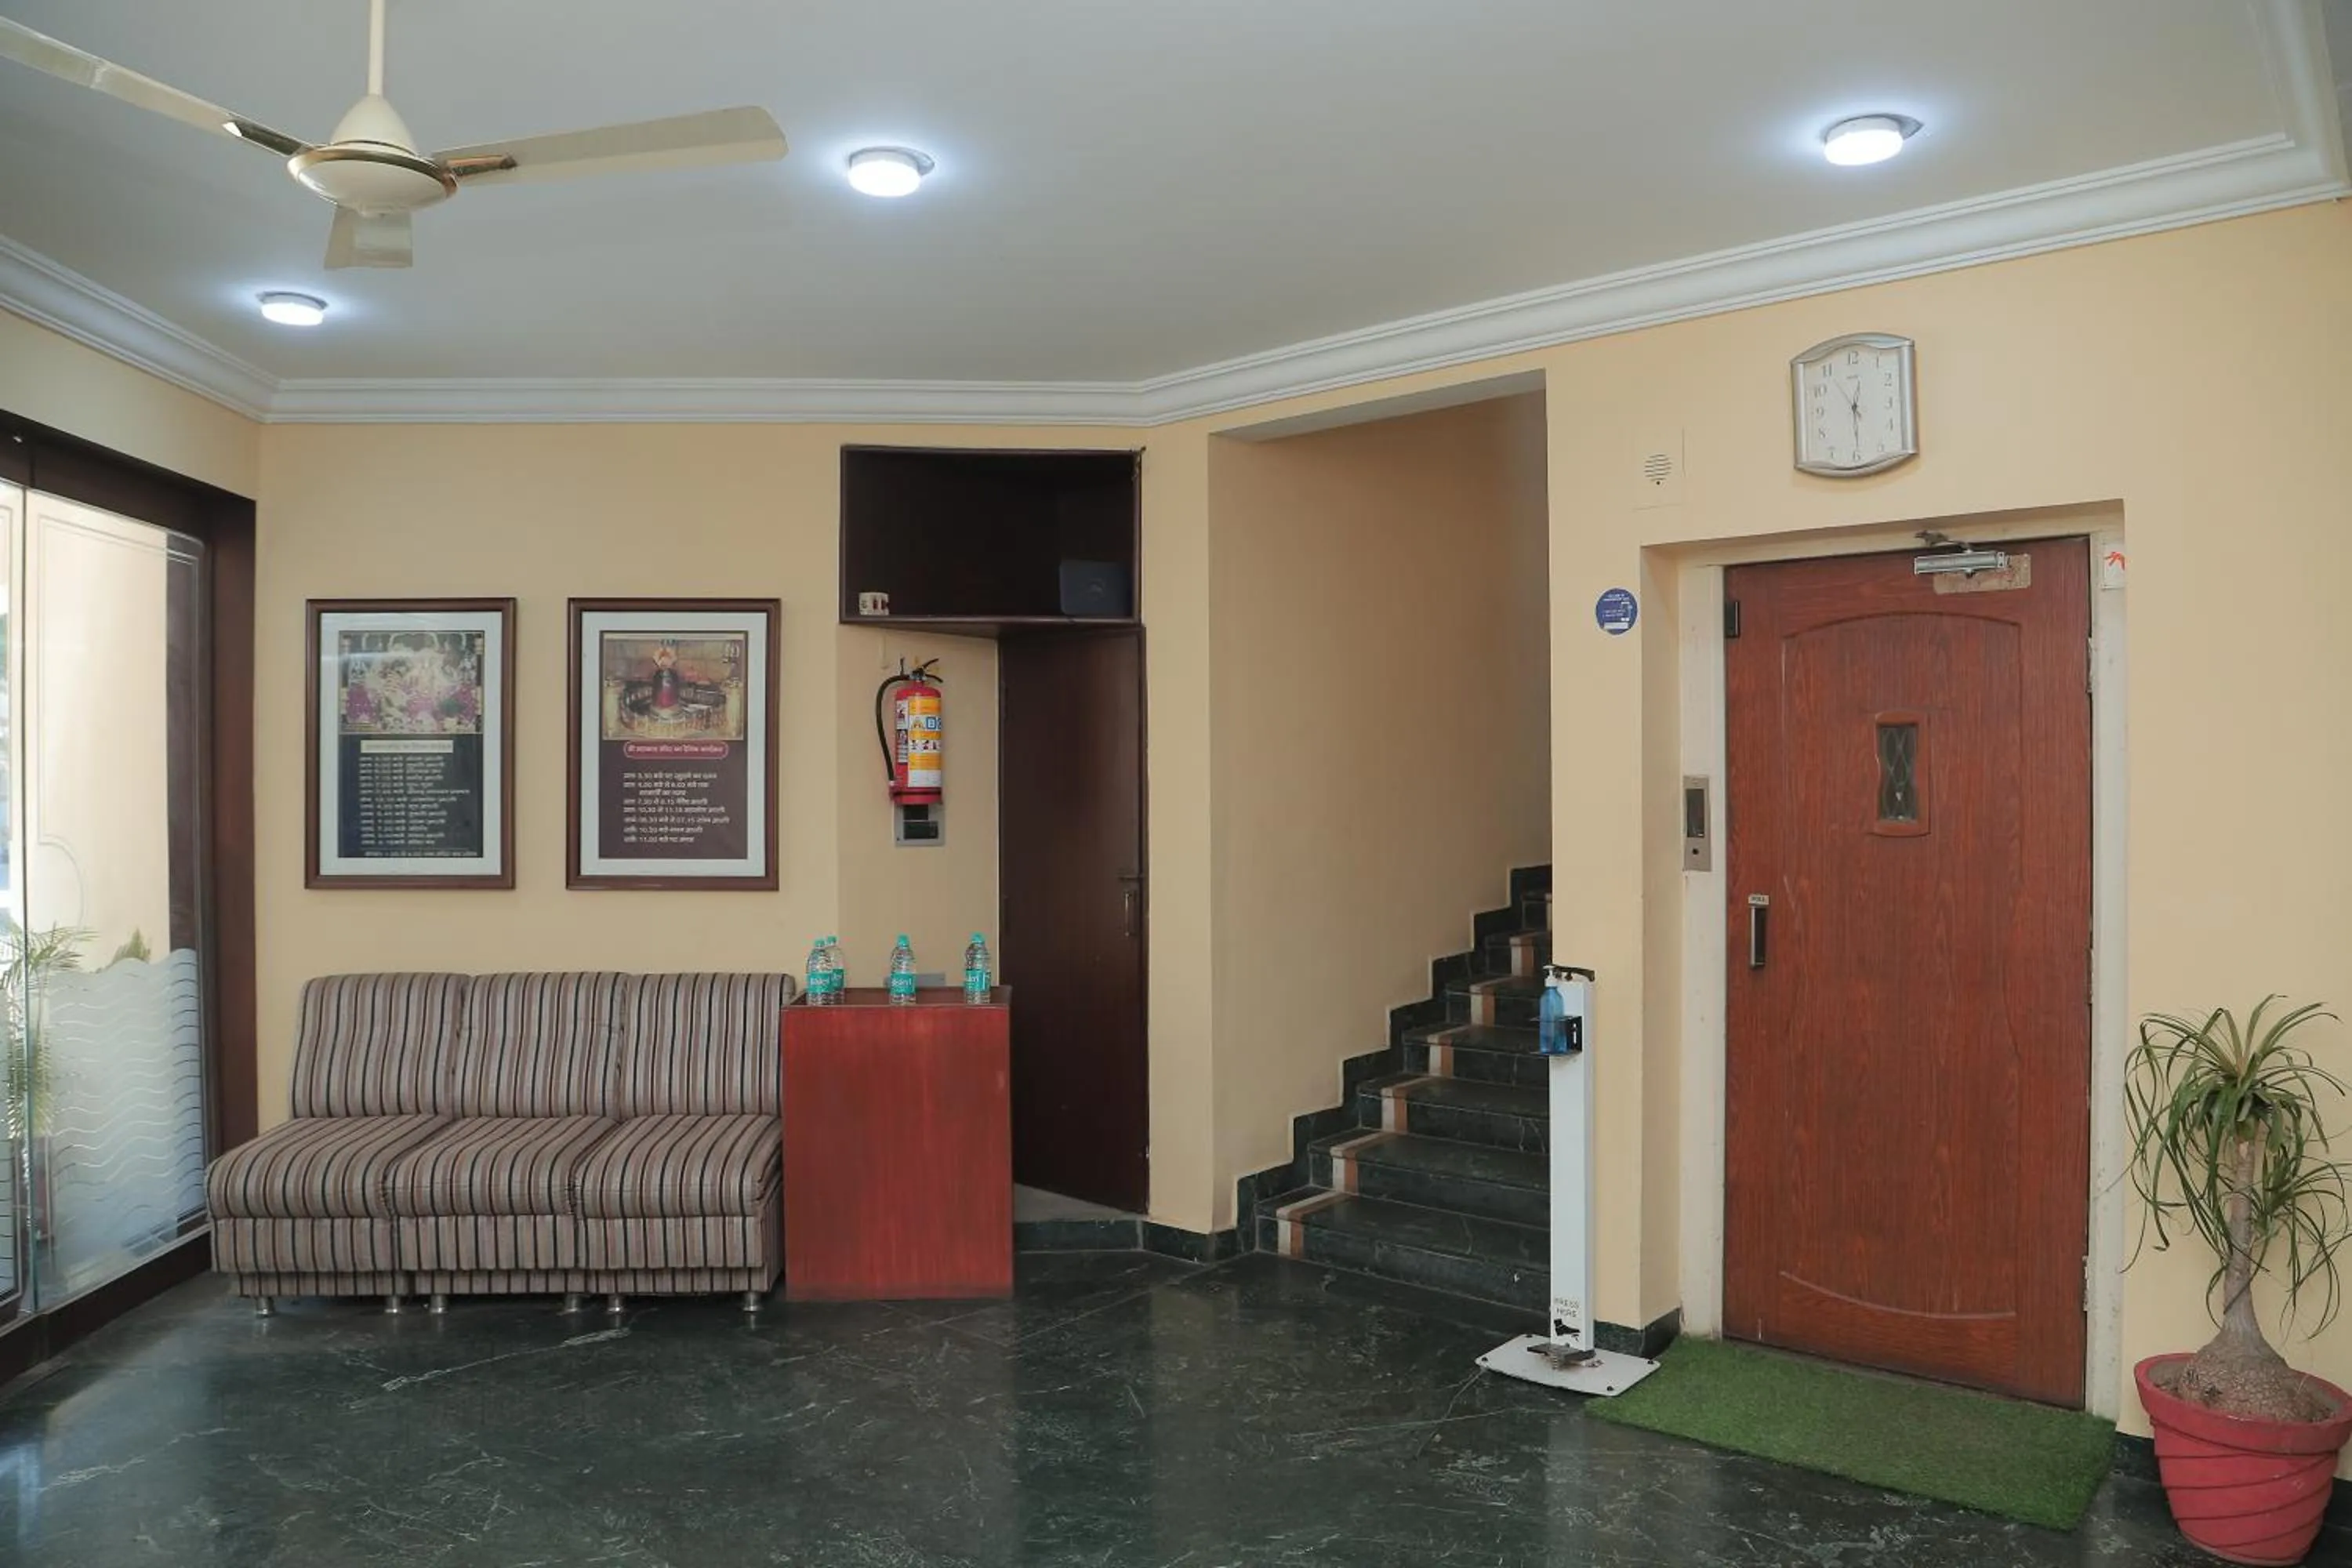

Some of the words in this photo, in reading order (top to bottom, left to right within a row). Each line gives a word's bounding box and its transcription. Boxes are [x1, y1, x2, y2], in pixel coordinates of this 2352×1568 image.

[1848, 350, 1859, 365] 12
[1822, 364, 1832, 377] 11
[1884, 372, 1892, 387] 2
[1814, 384, 1827, 398] 10
[1885, 397, 1893, 409] 3
[1816, 407, 1824, 419] 9
[1818, 427, 1826, 439] 8
[1853, 451, 1861, 463] 6
